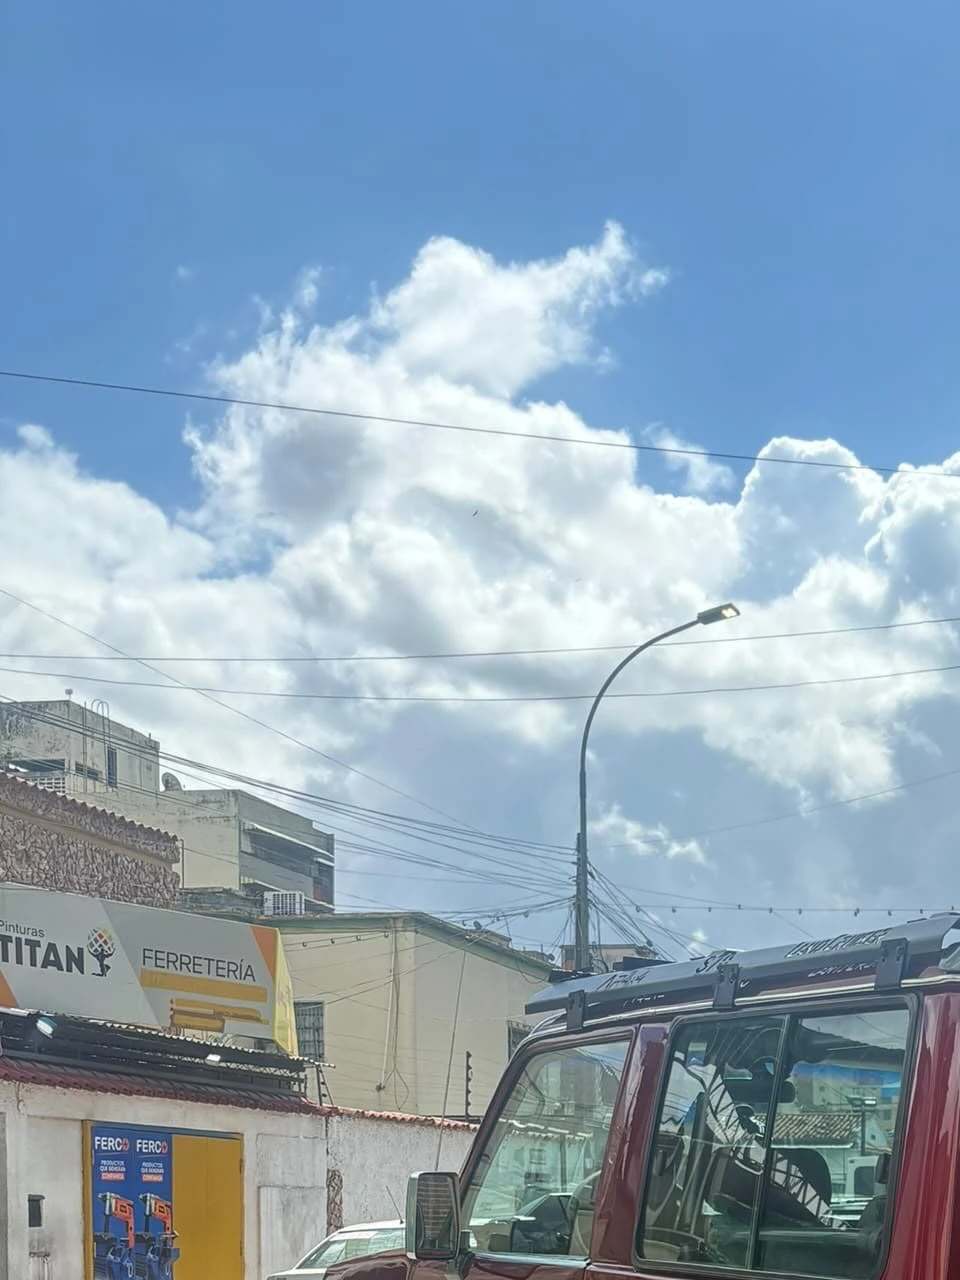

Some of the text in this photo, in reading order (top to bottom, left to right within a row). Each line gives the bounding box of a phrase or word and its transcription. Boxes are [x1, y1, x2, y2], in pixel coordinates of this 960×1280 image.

[0, 920, 46, 938] Pinturas
[0, 933, 85, 975] TITAN
[142, 947, 256, 983] FERRETERÍA
